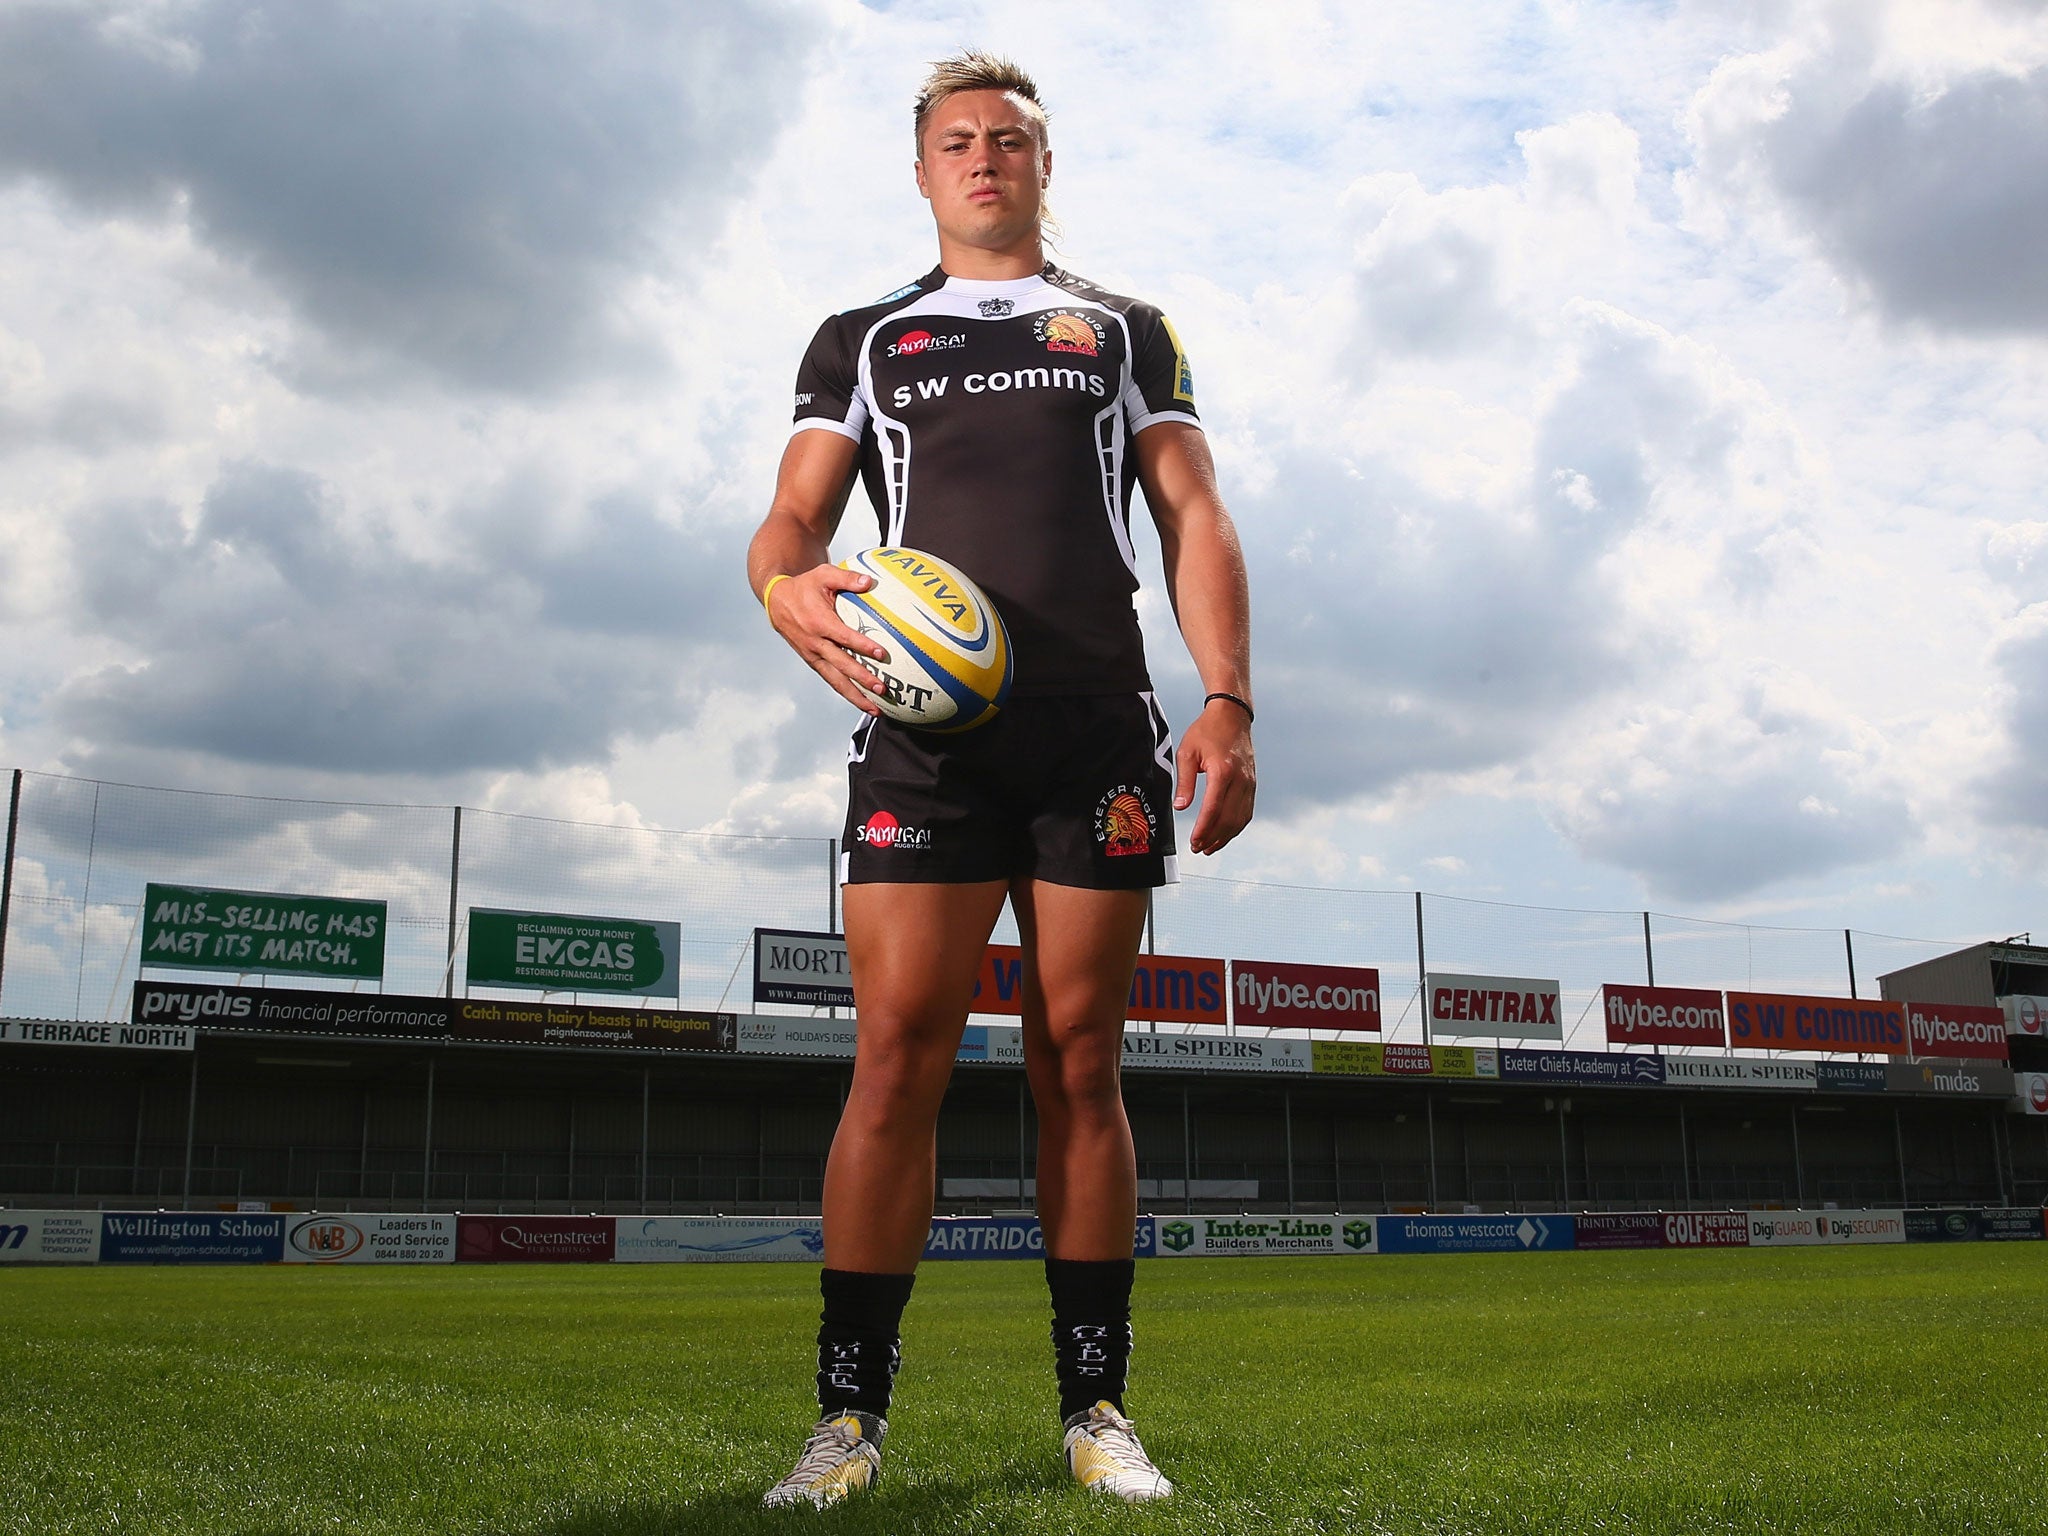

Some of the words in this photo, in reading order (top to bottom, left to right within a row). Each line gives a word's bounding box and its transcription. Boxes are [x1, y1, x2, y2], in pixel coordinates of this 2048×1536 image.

[1033, 309, 1068, 342] EXETER
[1074, 311, 1106, 348] RUGBY
[886, 333, 966, 358] SAMURAI
[963, 367, 1105, 398] comms
[892, 555, 968, 622] AVIVA
[1094, 784, 1127, 842] EXETER
[1132, 785, 1157, 838] RUGBY
[856, 825, 931, 843] SAMURAI
[152, 900, 320, 932] MIS-SELLING
[326, 911, 378, 938] HAS
[517, 924, 574, 935] RECLAIMING
[576, 927, 601, 937] YOUR
[603, 929, 636, 941] MONEY
[148, 929, 209, 957] MET
[213, 933, 252, 957] ITS
[260, 938, 358, 965] MATCH.
[770, 945, 852, 976] MORT
[515, 966, 559, 979] RESTORING
[560, 969, 602, 980] FINANCIAL
[604, 971, 634, 982] JUSTICE
[768, 988, 854, 1004] www.mortimers
[1236, 973, 1378, 1014] flybe.com
[141, 989, 252, 1021] prydis
[259, 998, 333, 1020] financial
[335, 1003, 448, 1028] performance
[1433, 986, 1558, 1025] CENTRAX
[1608, 995, 1723, 1033] flybe.com
[462, 1005, 501, 1021] Catch
[506, 1012, 543, 1024] more
[547, 1009, 584, 1028] hairy
[587, 1011, 631, 1028] beasts
[635, 1014, 647, 1027] in
[652, 1015, 710, 1034] Paignton
[1795, 1006, 1903, 1046] comms
[1911, 1012, 2006, 1046] flybe.com
[20, 1023, 111, 1043] TERRACE
[119, 1028, 187, 1047] NORTH
[544, 1027, 634, 1043] paigntonzoo.org.uk
[741, 1032, 776, 1040] exeter
[786, 1032, 830, 1043] HOLIDAYS
[1122, 1037, 1168, 1055] AEL
[1175, 1039, 1262, 1059] SPIERS
[1385, 1046, 1428, 1057] RADMORE
[1444, 1049, 1463, 1058] 01392
[1271, 1058, 1305, 1068] ROLEX
[1504, 1055, 1537, 1071] Exeter
[1540, 1056, 1571, 1073] Chiefs
[1573, 1058, 1618, 1079] Academy
[1620, 1061, 1632, 1075] at
[1667, 1058, 1747, 1079] MICHAEL
[1752, 1064, 1816, 1082] SPIERS
[1826, 1067, 1856, 1079] DARTS
[1859, 1068, 1885, 1081] FARM
[1933, 1069, 1980, 1092] midas
[43, 1218, 82, 1226] EXETER
[106, 1217, 210, 1240] Wellington
[219, 1219, 279, 1238] School
[379, 1219, 427, 1231] Leaders
[431, 1219, 442, 1230] In
[684, 1220, 733, 1228] COMPLETE
[735, 1220, 796, 1228] COMMERCIAL
[1204, 1218, 1333, 1237] Inter-Line
[1405, 1220, 1454, 1238] thomas
[1458, 1224, 1516, 1237] westcott
[1575, 1216, 1616, 1229] TRINITY
[1619, 1215, 1661, 1228] SCHOOL
[1665, 1214, 1704, 1244] GOLF
[1704, 1215, 1746, 1227] NEWTON
[1753, 1220, 1812, 1241] DigiGUARD
[1832, 1219, 1901, 1240] DigiSECURITY
[42, 1227, 93, 1236] EXMOUTH
[42, 1236, 92, 1245] TIVERTON
[370, 1234, 401, 1246] Food
[405, 1234, 449, 1246] Service
[500, 1225, 607, 1250] Queenstreet
[925, 1226, 1047, 1250] ARTRIDG
[1705, 1229, 1718, 1242] St.
[1719, 1230, 1747, 1243] CYRES
[41, 1246, 89, 1255] TORQUAY
[120, 1244, 264, 1257] www.wellington-school.org.uk
[618, 1236, 678, 1249] Betterclean
[1205, 1238, 1259, 1249] Builders
[1265, 1238, 1333, 1249] Merchants
[1437, 1238, 1473, 1248] chartered
[1474, 1239, 1516, 1248] accountants
[375, 1250, 397, 1259] 0844
[419, 1249, 430, 1259] 20
[432, 1249, 443, 1258] 20
